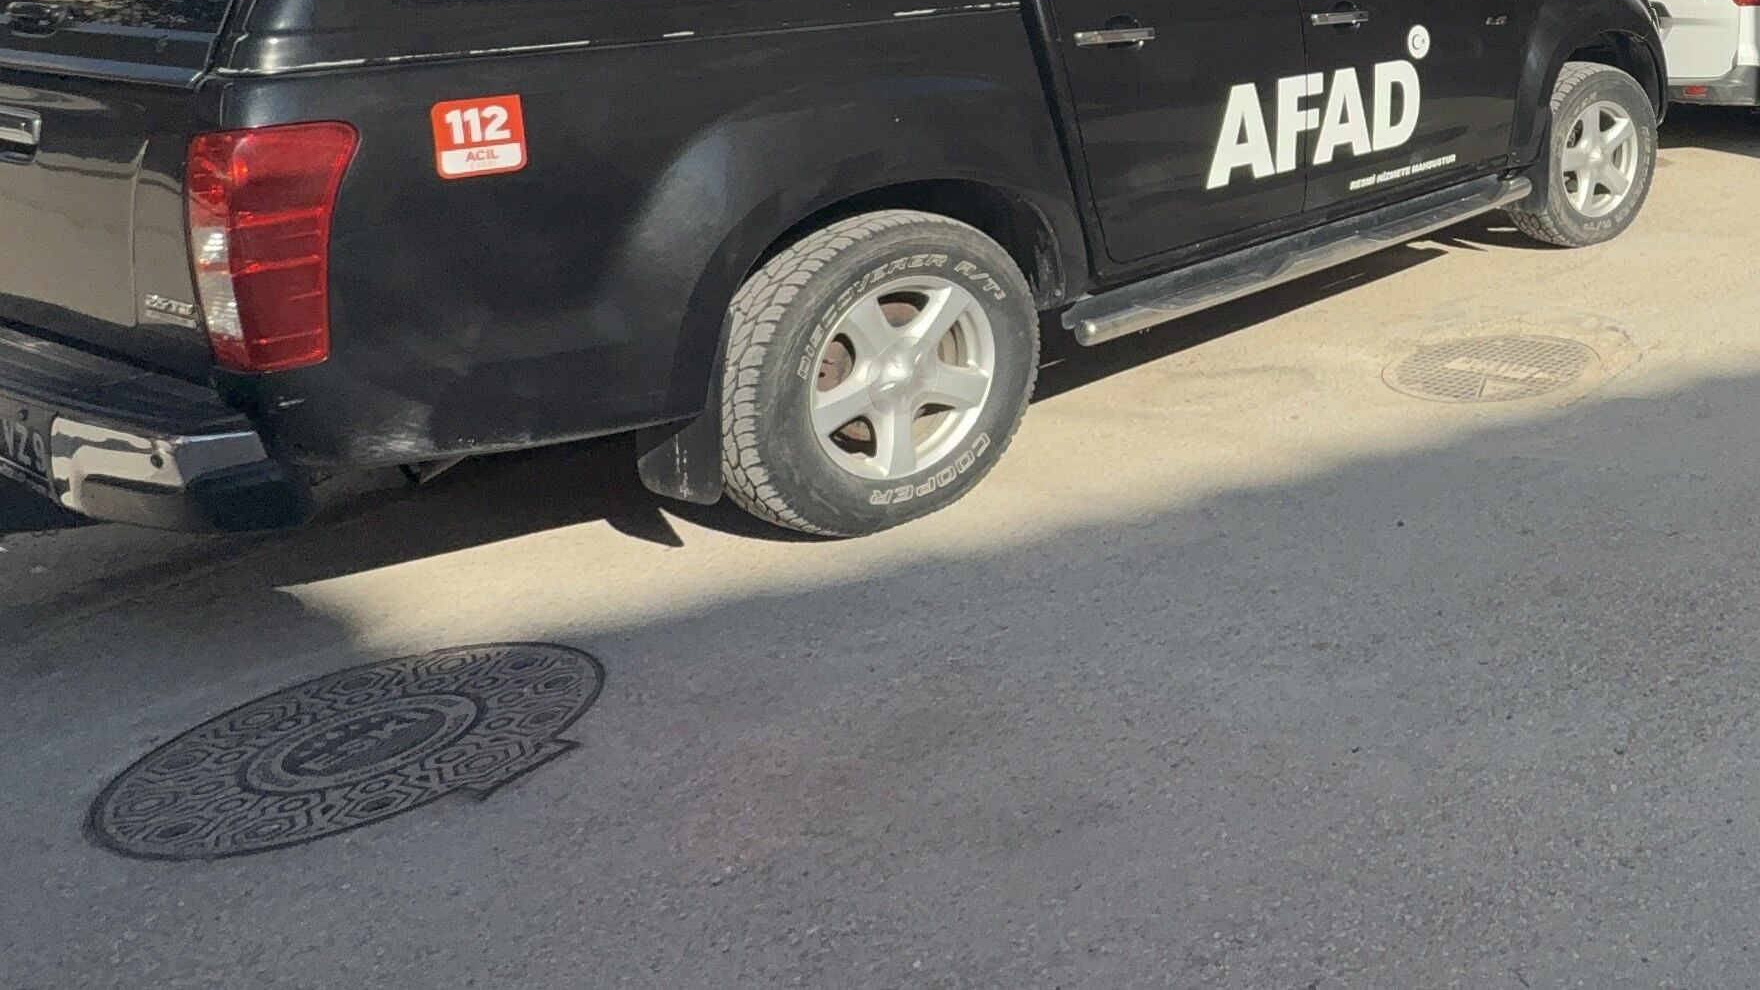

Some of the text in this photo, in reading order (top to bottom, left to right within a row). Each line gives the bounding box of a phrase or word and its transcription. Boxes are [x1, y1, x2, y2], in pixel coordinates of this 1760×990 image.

[445, 105, 511, 145] 112
[1206, 59, 1421, 191] AFAD
[869, 432, 991, 506] COOPER
